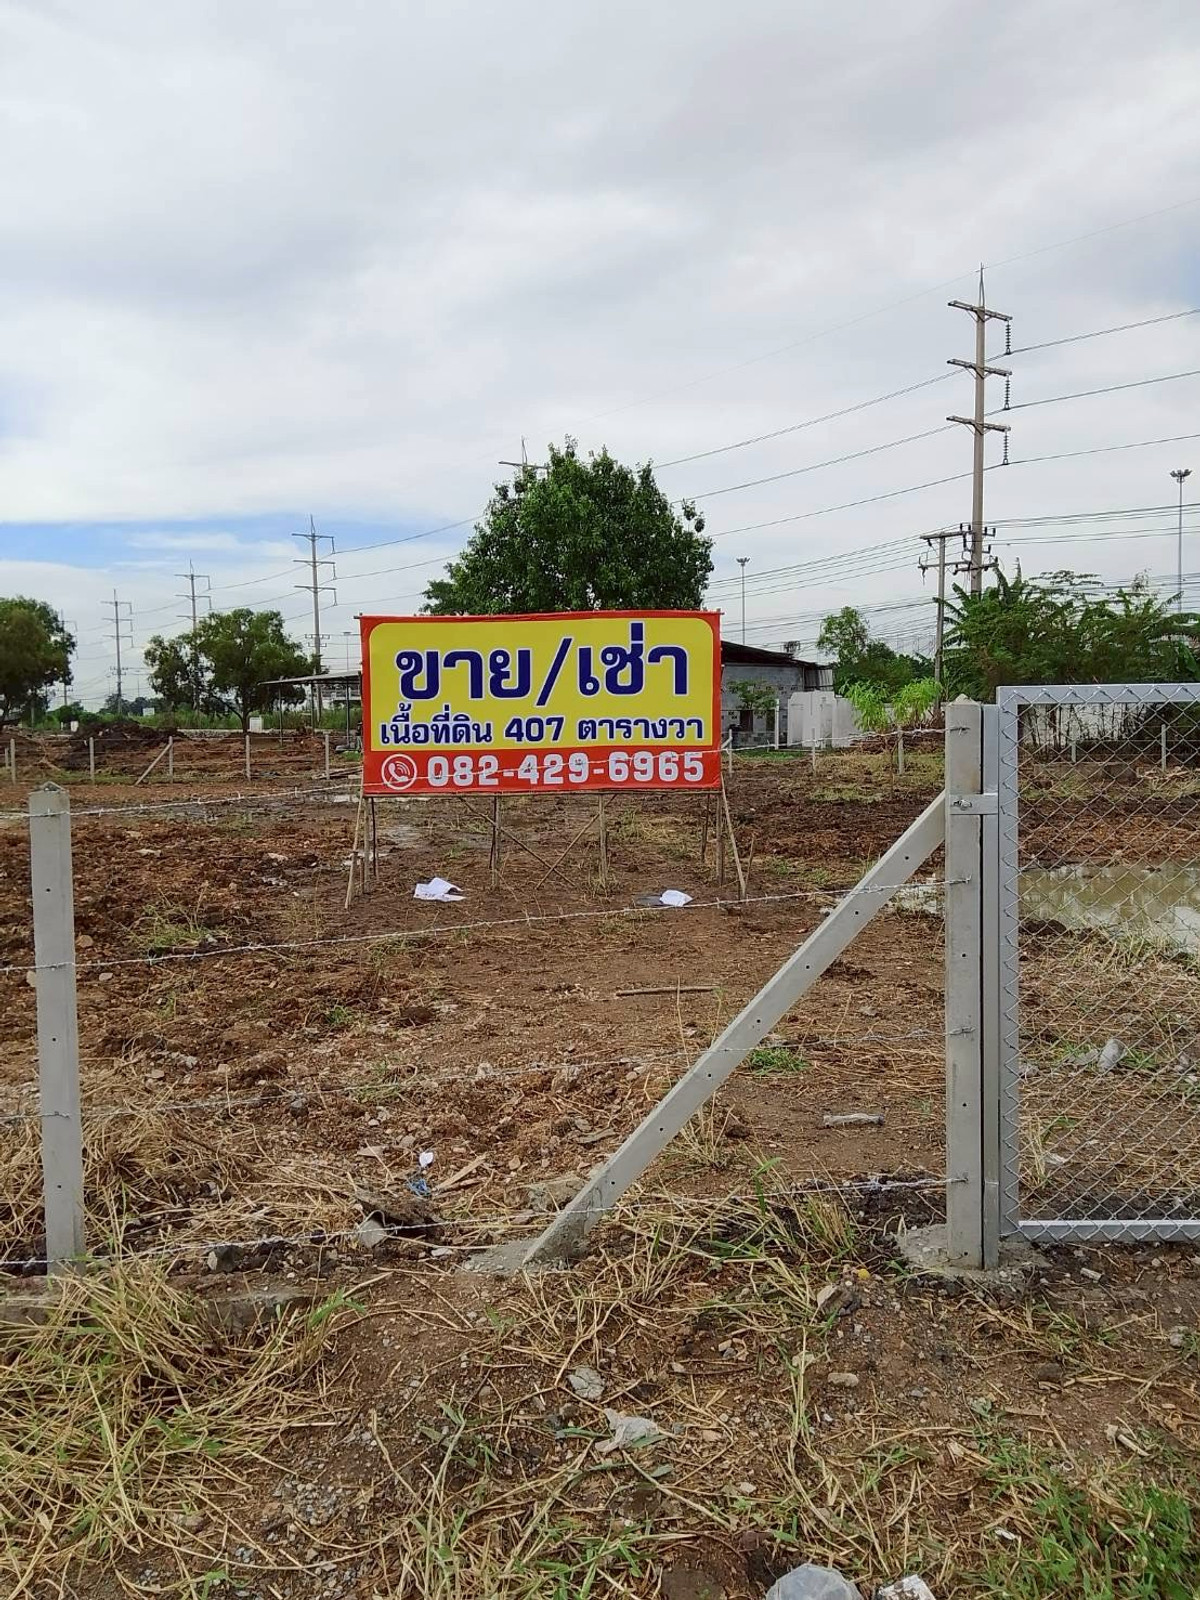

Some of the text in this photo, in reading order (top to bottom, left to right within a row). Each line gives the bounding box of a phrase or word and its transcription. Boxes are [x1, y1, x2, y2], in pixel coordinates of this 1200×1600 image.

[396, 622, 688, 706] ขาย/เช่า
[380, 703, 704, 745] เนื้อที่ดิน 407 ตารางวา
[426, 751, 704, 787] 082-429-6965
